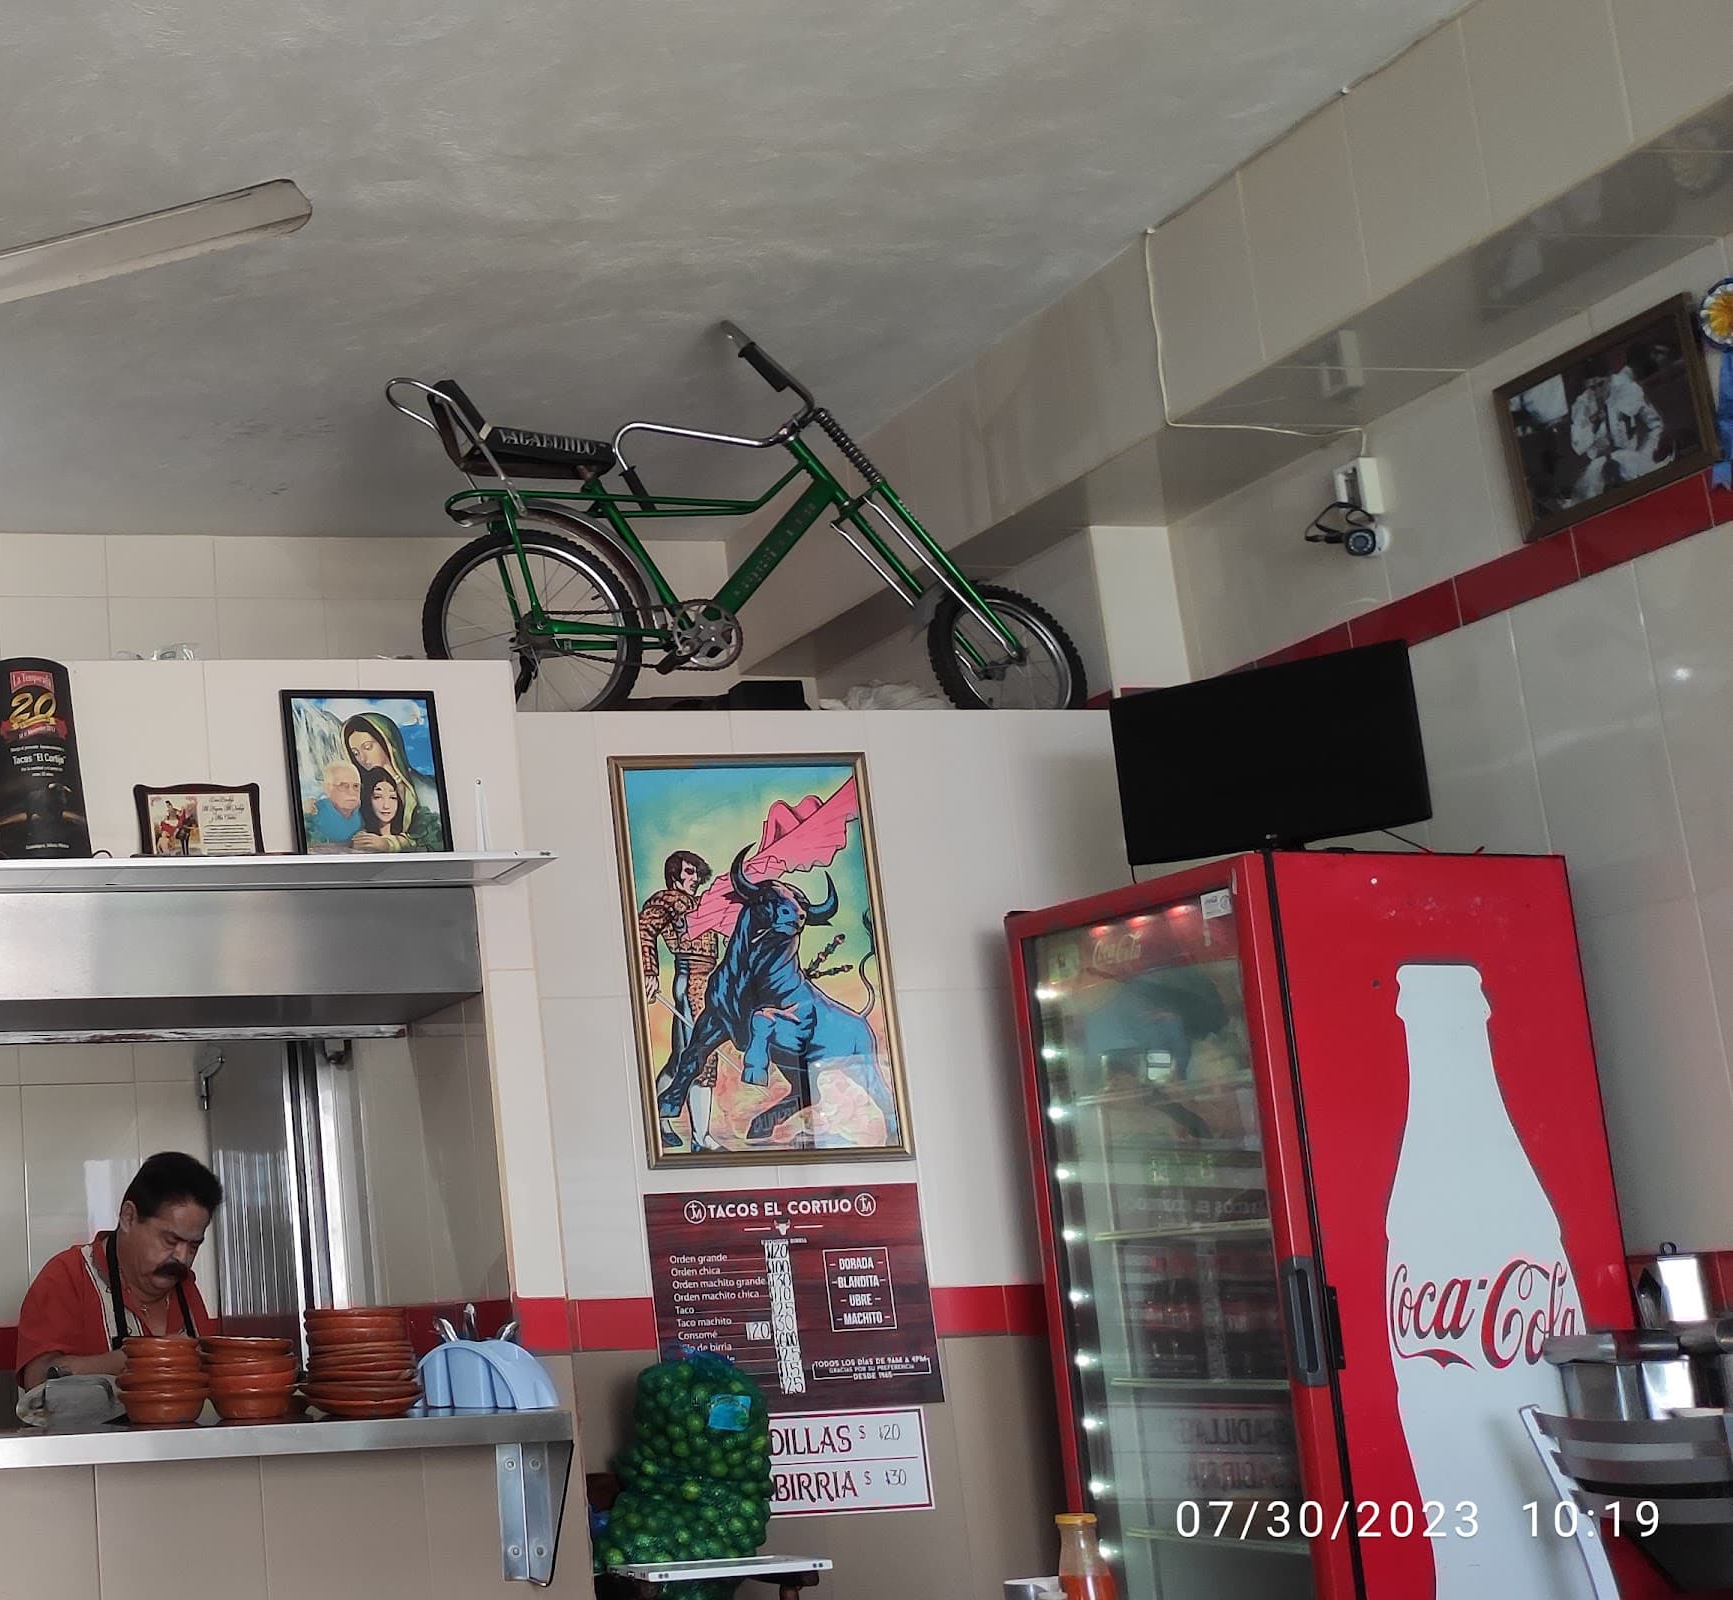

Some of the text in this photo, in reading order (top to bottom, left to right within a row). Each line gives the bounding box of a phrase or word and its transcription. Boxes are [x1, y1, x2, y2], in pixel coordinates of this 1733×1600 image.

[8, 692, 58, 727] 20
[707, 1203, 759, 1219] TACOS
[764, 1202, 782, 1216] EL
[787, 1199, 852, 1215] CORTIJO
[669, 1253, 728, 1265] Orden grande
[838, 1256, 874, 1271] DORADA
[670, 1265, 721, 1277] Orden chica
[672, 1276, 766, 1290] Orden machito grande
[837, 1275, 880, 1289] BLANDITA
[674, 1289, 760, 1303] Orden machito chica
[849, 1293, 873, 1307] UBRE
[675, 1306, 695, 1315] Taco
[676, 1316, 733, 1328] Taco machito
[843, 1311, 883, 1325] MACHITO
[678, 1330, 718, 1341] Consomé
[709, 1341, 732, 1352] birria
[814, 1360, 840, 1368] TODOS
[772, 1470, 859, 1503] BIRRIA
